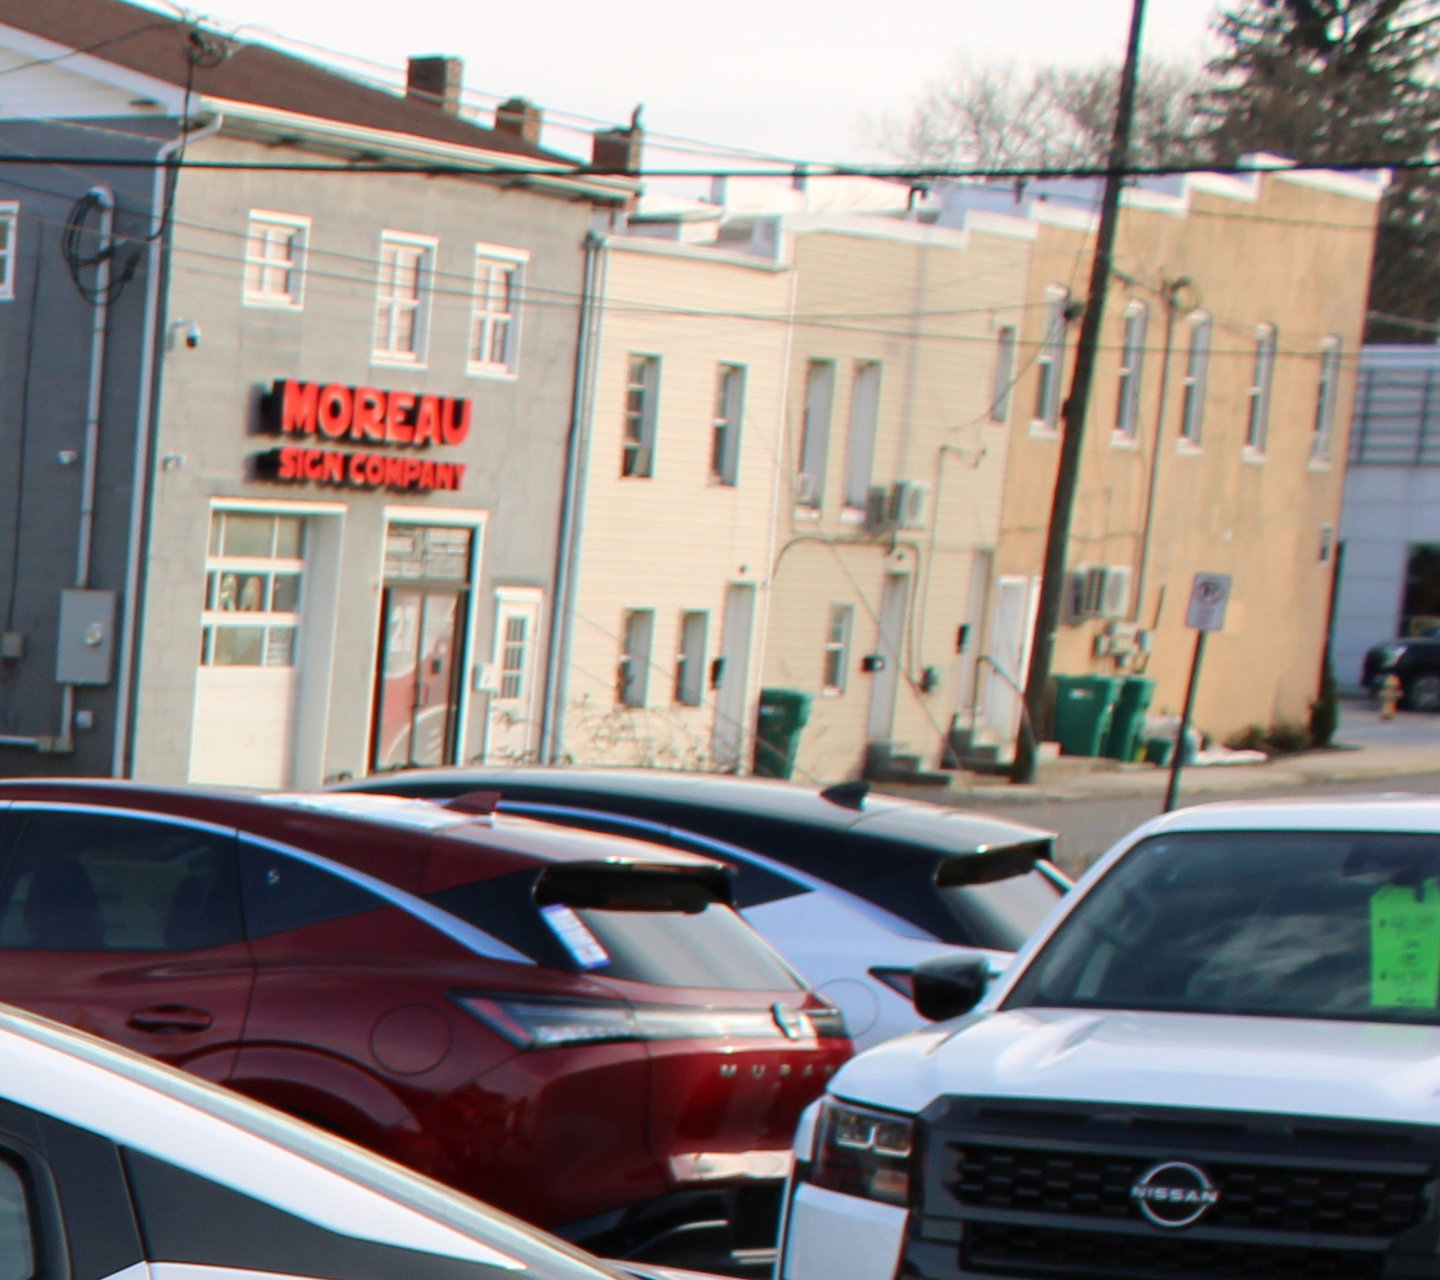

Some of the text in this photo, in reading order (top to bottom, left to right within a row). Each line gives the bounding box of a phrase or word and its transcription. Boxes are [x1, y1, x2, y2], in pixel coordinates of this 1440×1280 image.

[282, 378, 473, 446] MOREAU
[278, 446, 467, 491] SIGN COMPANY
[719, 1063, 837, 1080] MURAN
[1131, 1186, 1219, 1203] NISSAN
